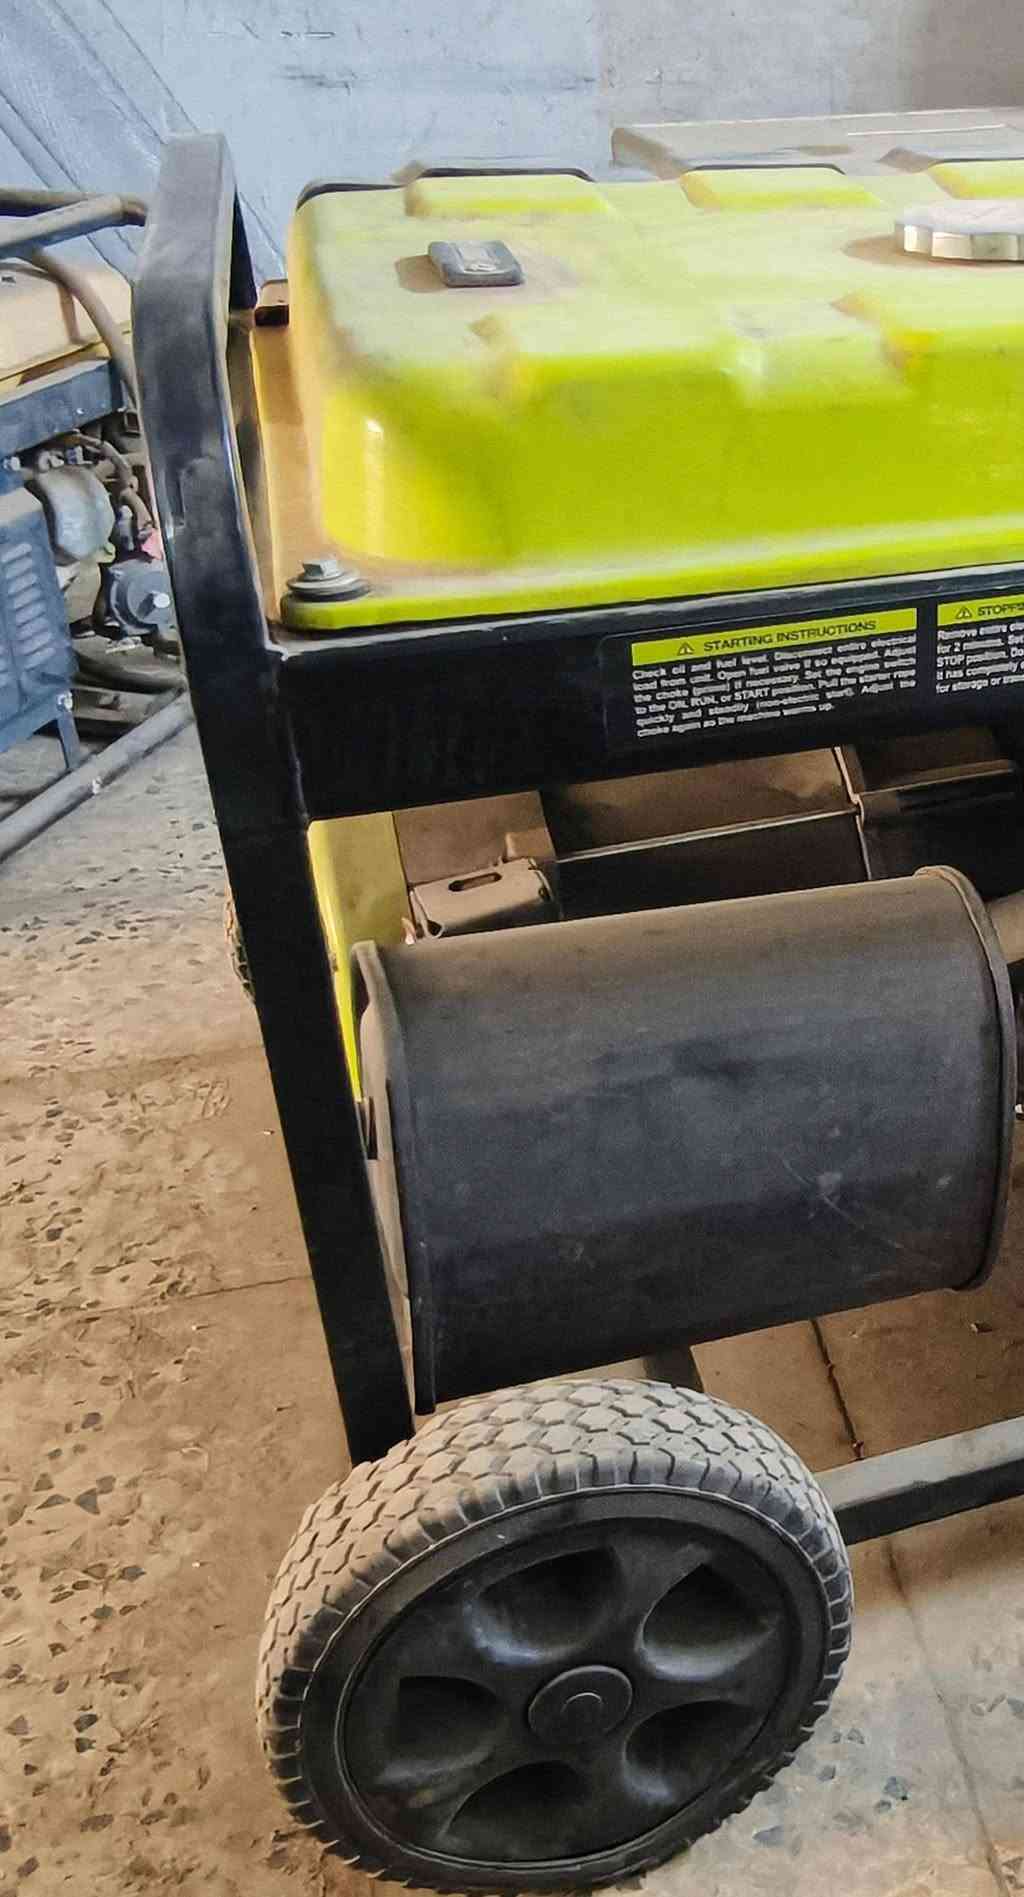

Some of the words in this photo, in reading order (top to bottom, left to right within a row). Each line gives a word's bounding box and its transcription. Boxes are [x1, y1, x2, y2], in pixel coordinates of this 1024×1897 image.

[703, 632, 772, 652] STARTING
[776, 619, 876, 642] INSTRUCTIONS
[937, 642, 951, 654] for
[953, 641, 960, 651] 2
[936, 653, 964, 667] STOP
[1010, 646, 1023, 656] Do
[631, 666, 666, 680] Check
[671, 663, 685, 674] oil
[716, 667, 746, 681] Open
[945, 668, 963, 678] has
[935, 682, 949, 693] for
[990, 677, 1001, 685] or
[633, 692, 652, 703] the
[635, 704, 646, 715] to
[648, 702, 666, 713] the
[720, 693, 731, 702] or
[734, 687, 769, 701] START
